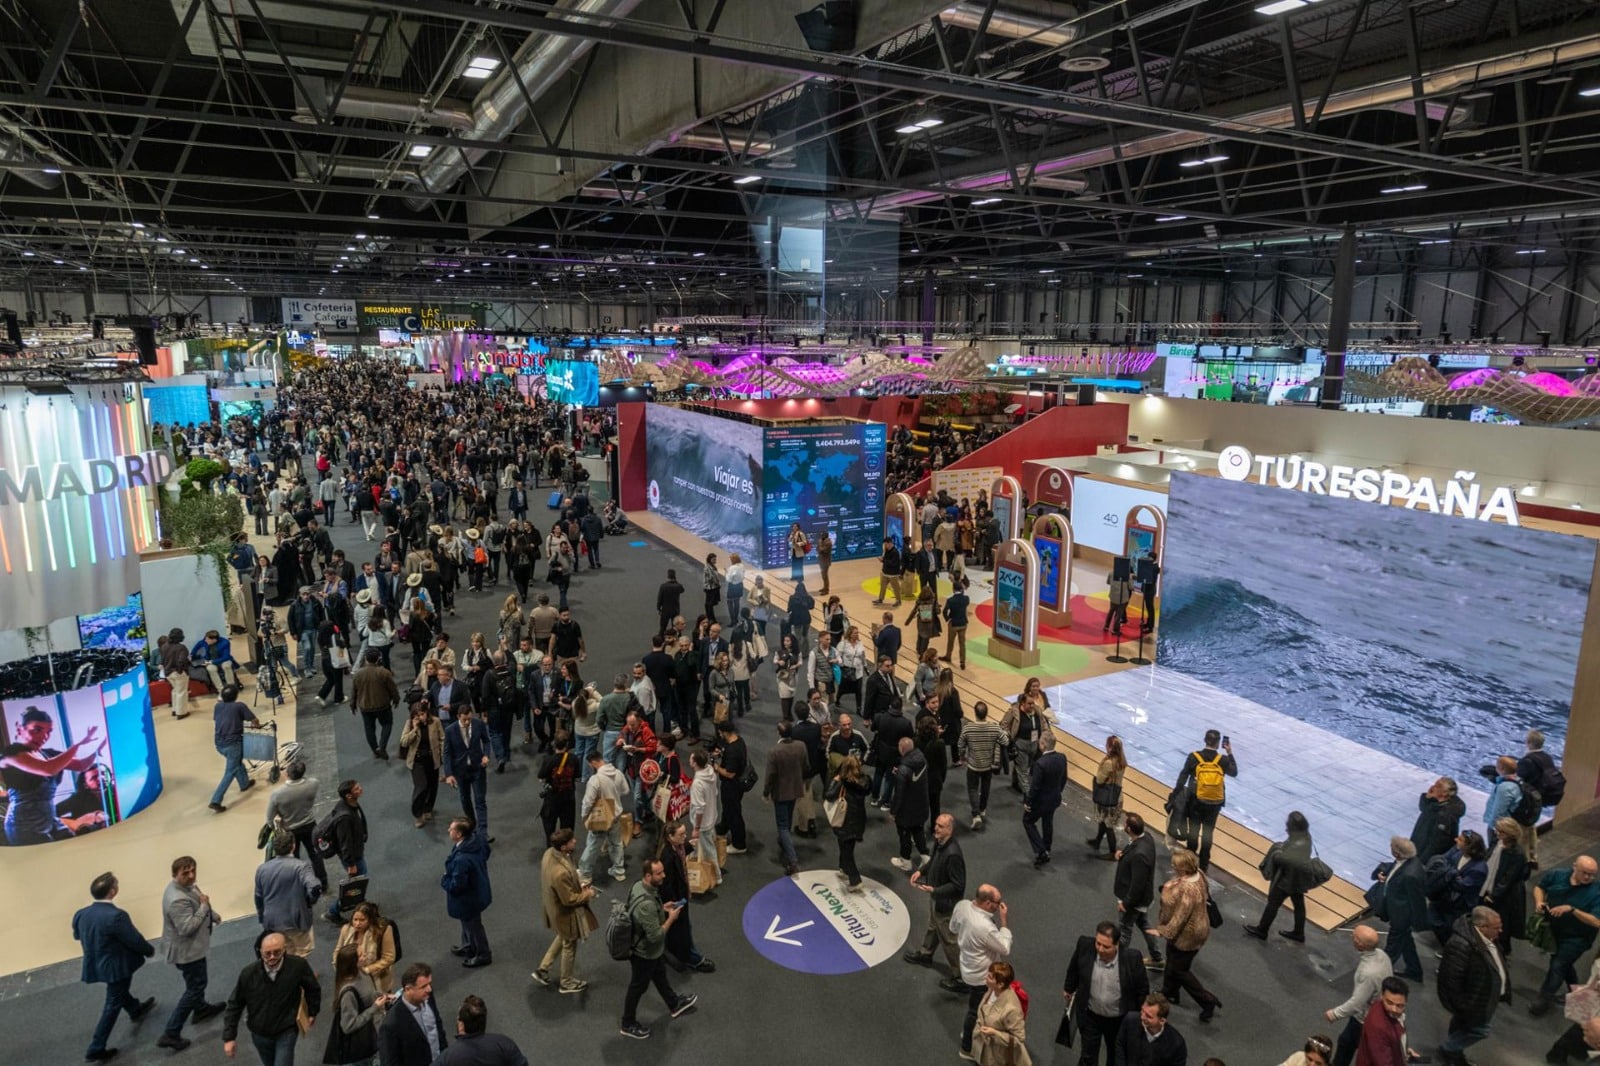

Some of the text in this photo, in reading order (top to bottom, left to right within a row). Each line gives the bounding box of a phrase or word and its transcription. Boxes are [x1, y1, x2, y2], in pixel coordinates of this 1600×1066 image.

[364, 306, 413, 314] RESTAURANTE
[421, 308, 440, 318] LAS
[404, 316, 417, 331] C
[0, 450, 173, 506] MADRID
[714, 465, 754, 495] Viajar es
[1254, 453, 1520, 526] TURESPAÑA
[715, 491, 733, 508] propias
[1103, 513, 1119, 525] 40
[998, 570, 1024, 588] スペイン
